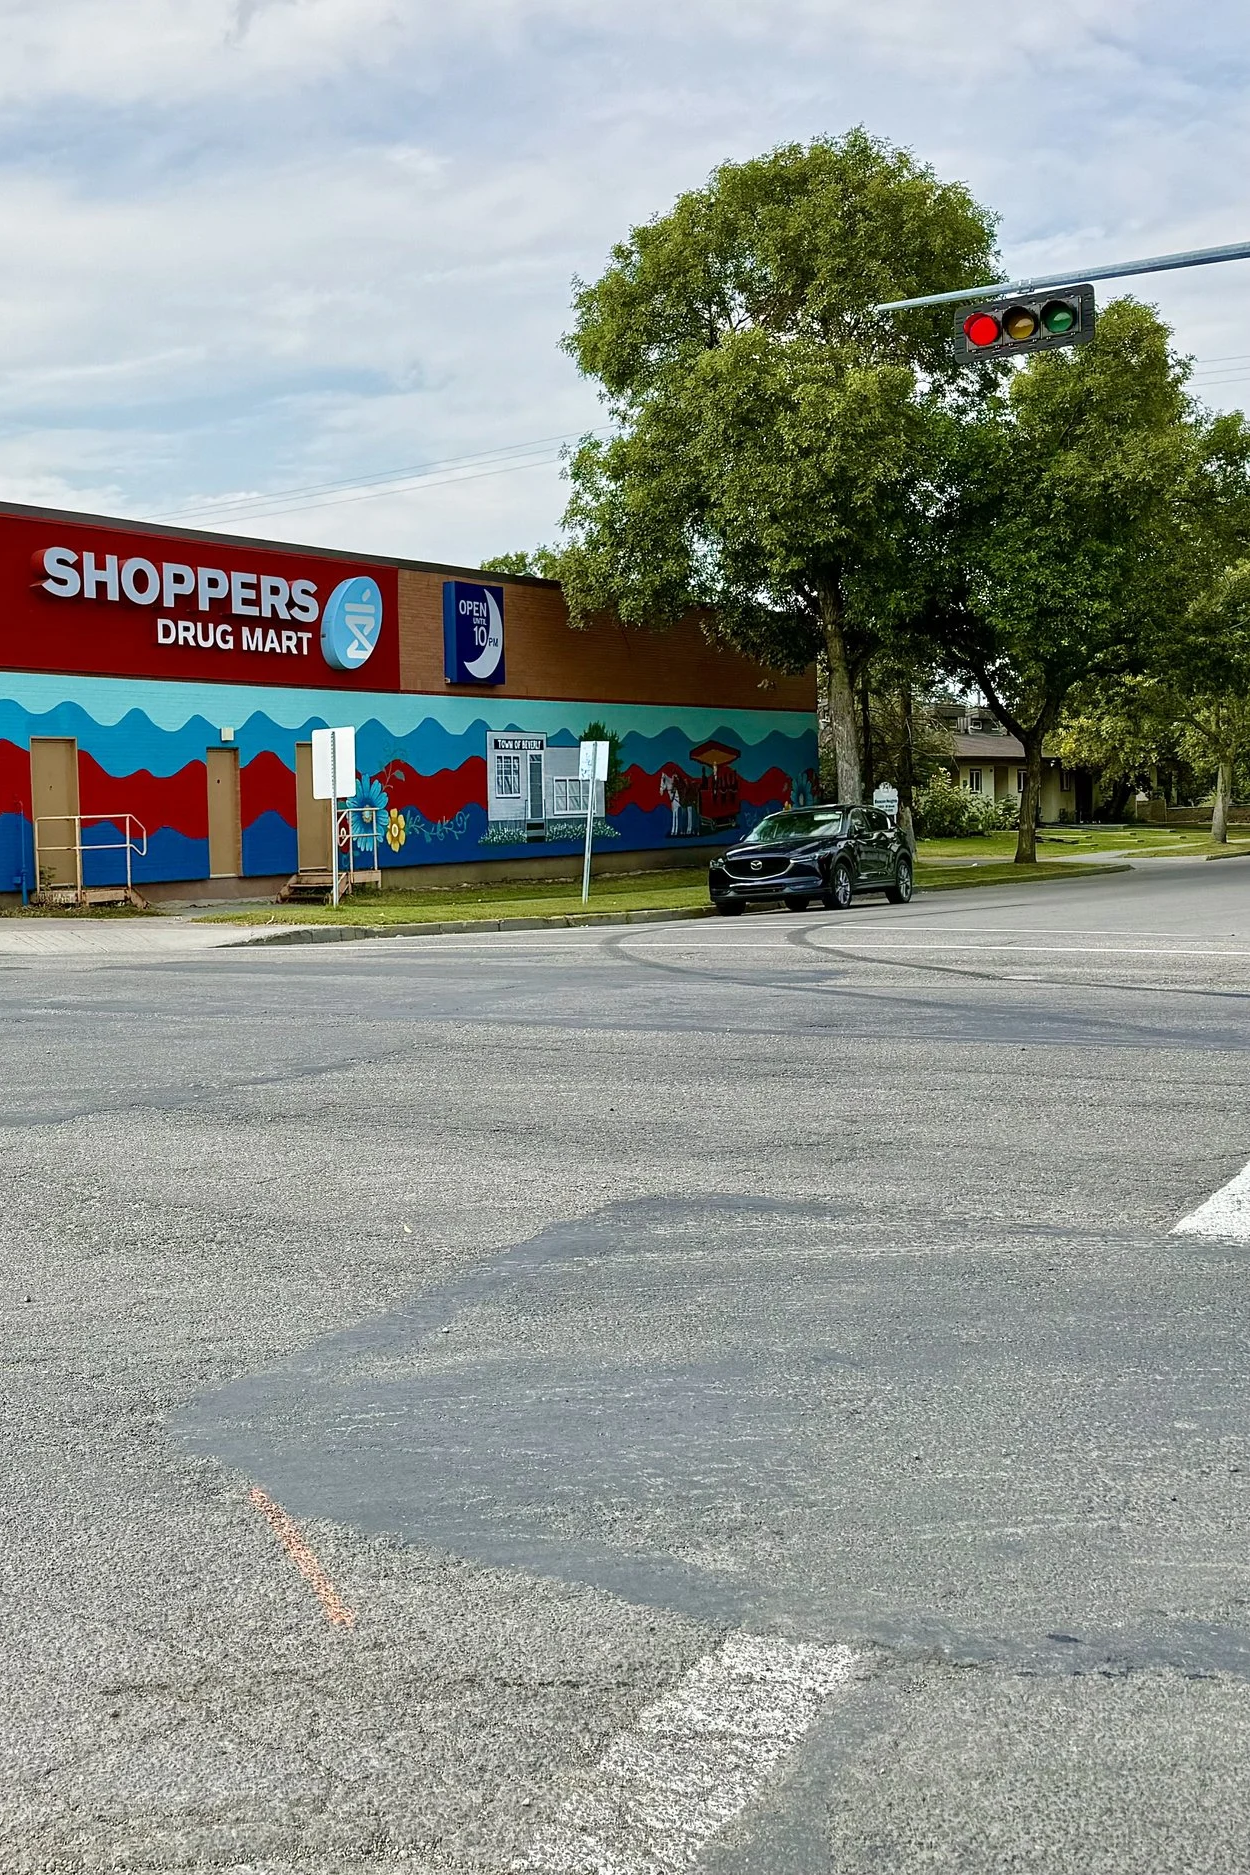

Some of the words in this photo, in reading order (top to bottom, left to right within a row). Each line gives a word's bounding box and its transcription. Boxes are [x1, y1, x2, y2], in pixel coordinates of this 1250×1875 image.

[42, 546, 320, 623] SHOPPERS
[458, 599, 487, 618] OPEN
[473, 617, 488, 626] UNTIL
[157, 618, 233, 650] DRUG
[241, 626, 312, 655] MART
[473, 626, 488, 647] 10
[488, 637, 499, 648] PM
[497, 739, 514, 749] TOWN
[514, 739, 522, 749] OF
[521, 739, 542, 750] BEVERLY
